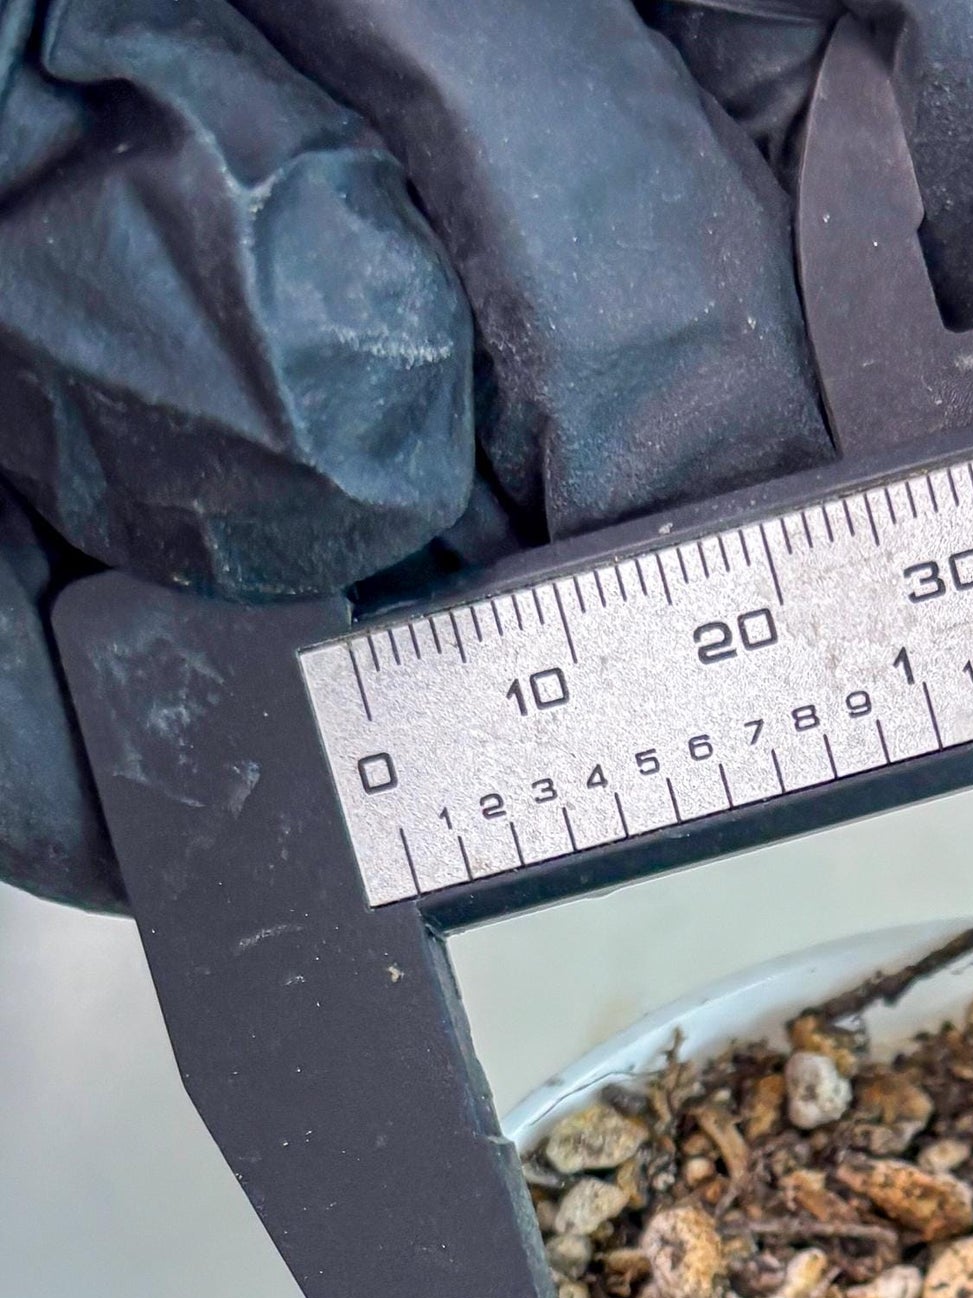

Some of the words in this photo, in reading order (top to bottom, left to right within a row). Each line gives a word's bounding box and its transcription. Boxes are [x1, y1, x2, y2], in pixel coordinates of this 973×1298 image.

[357, 752, 398, 794] 0
[506, 667, 569, 716] 10
[693, 608, 778, 664] 20
[439, 807, 453, 829] 1
[479, 793, 507, 819] 2
[531, 778, 559, 803] 3
[586, 764, 608, 788] 4
[635, 748, 661, 775] 5
[688, 734, 714, 761] 6
[744, 719, 765, 745] 7
[791, 704, 820, 731] 8
[845, 690, 873, 718] 9
[893, 647, 915, 685] 1
